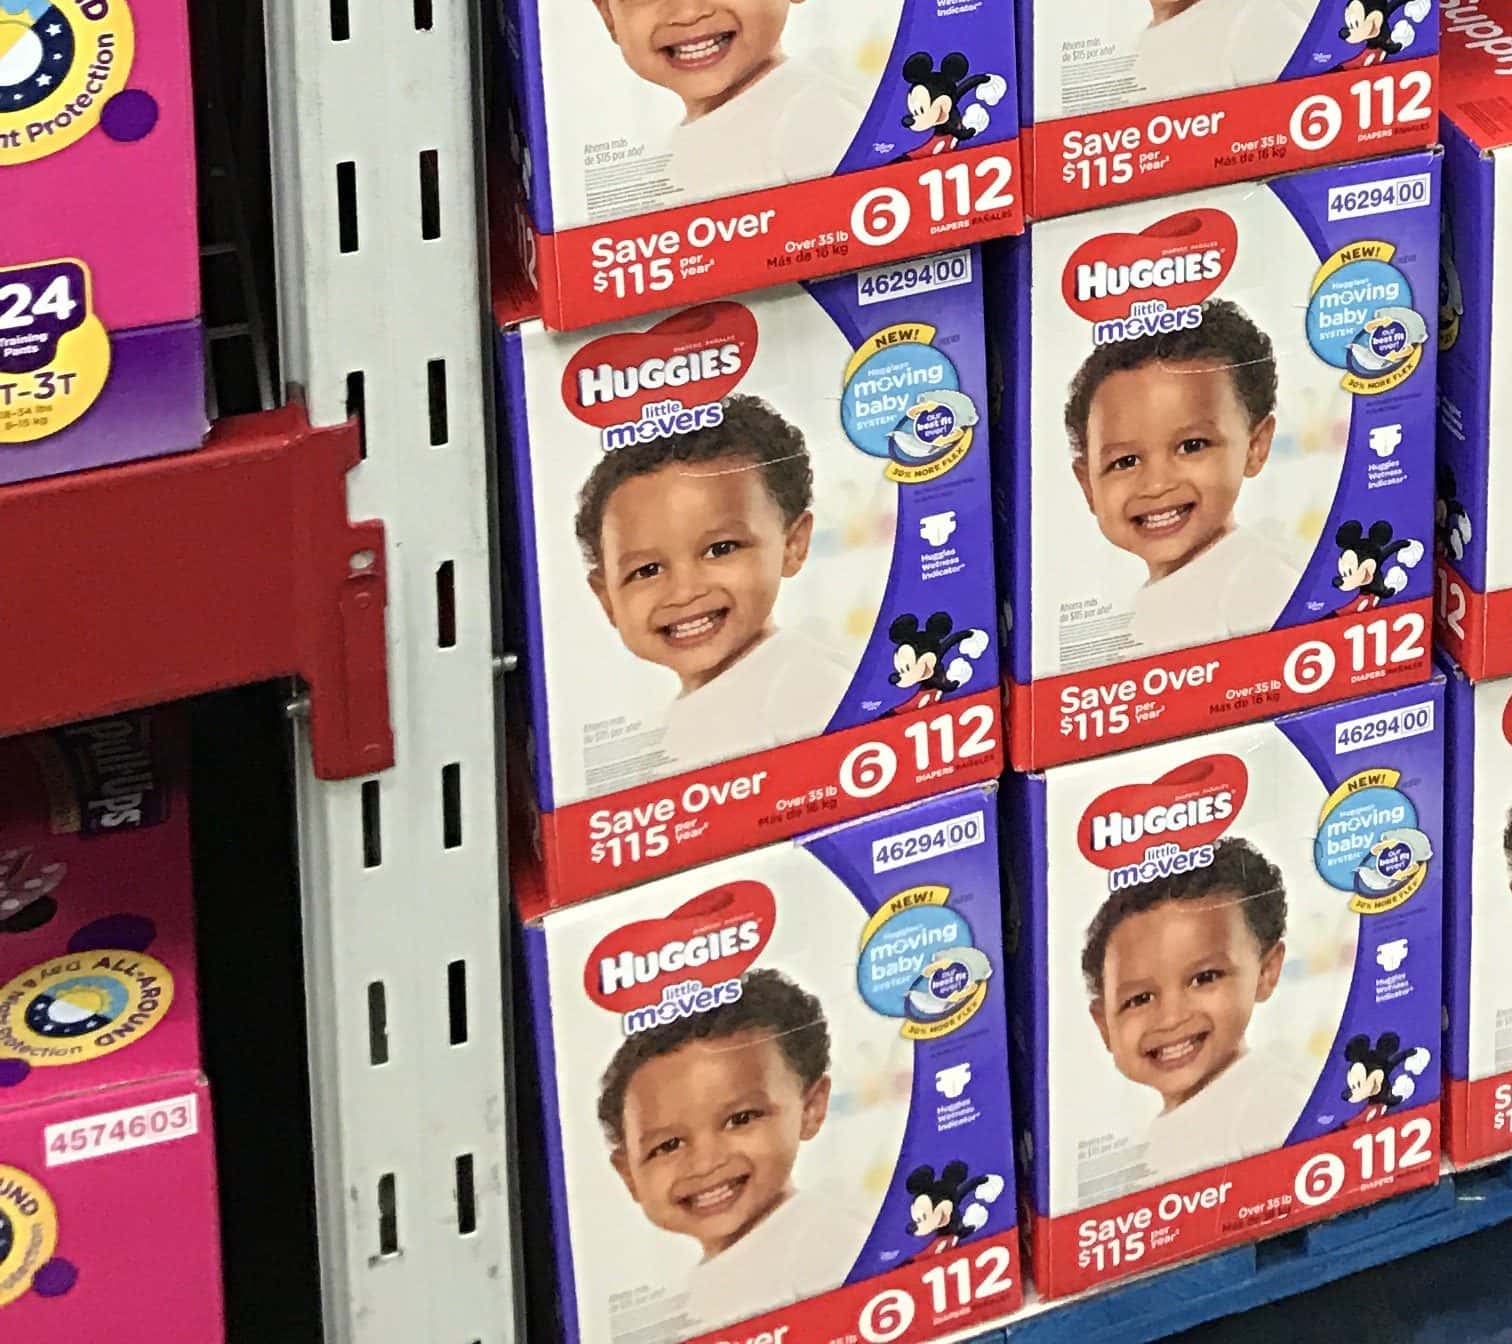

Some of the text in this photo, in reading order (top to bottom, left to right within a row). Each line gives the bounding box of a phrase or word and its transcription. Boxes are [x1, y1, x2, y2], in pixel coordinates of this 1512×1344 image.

[1349, 69, 1433, 130] 112
[918, 156, 1014, 220] 112
[591, 209, 776, 271] Save Over
[592, 256, 674, 299] $115
[577, 344, 744, 408] HUGGIES
[1351, 1116, 1433, 1182] 112
